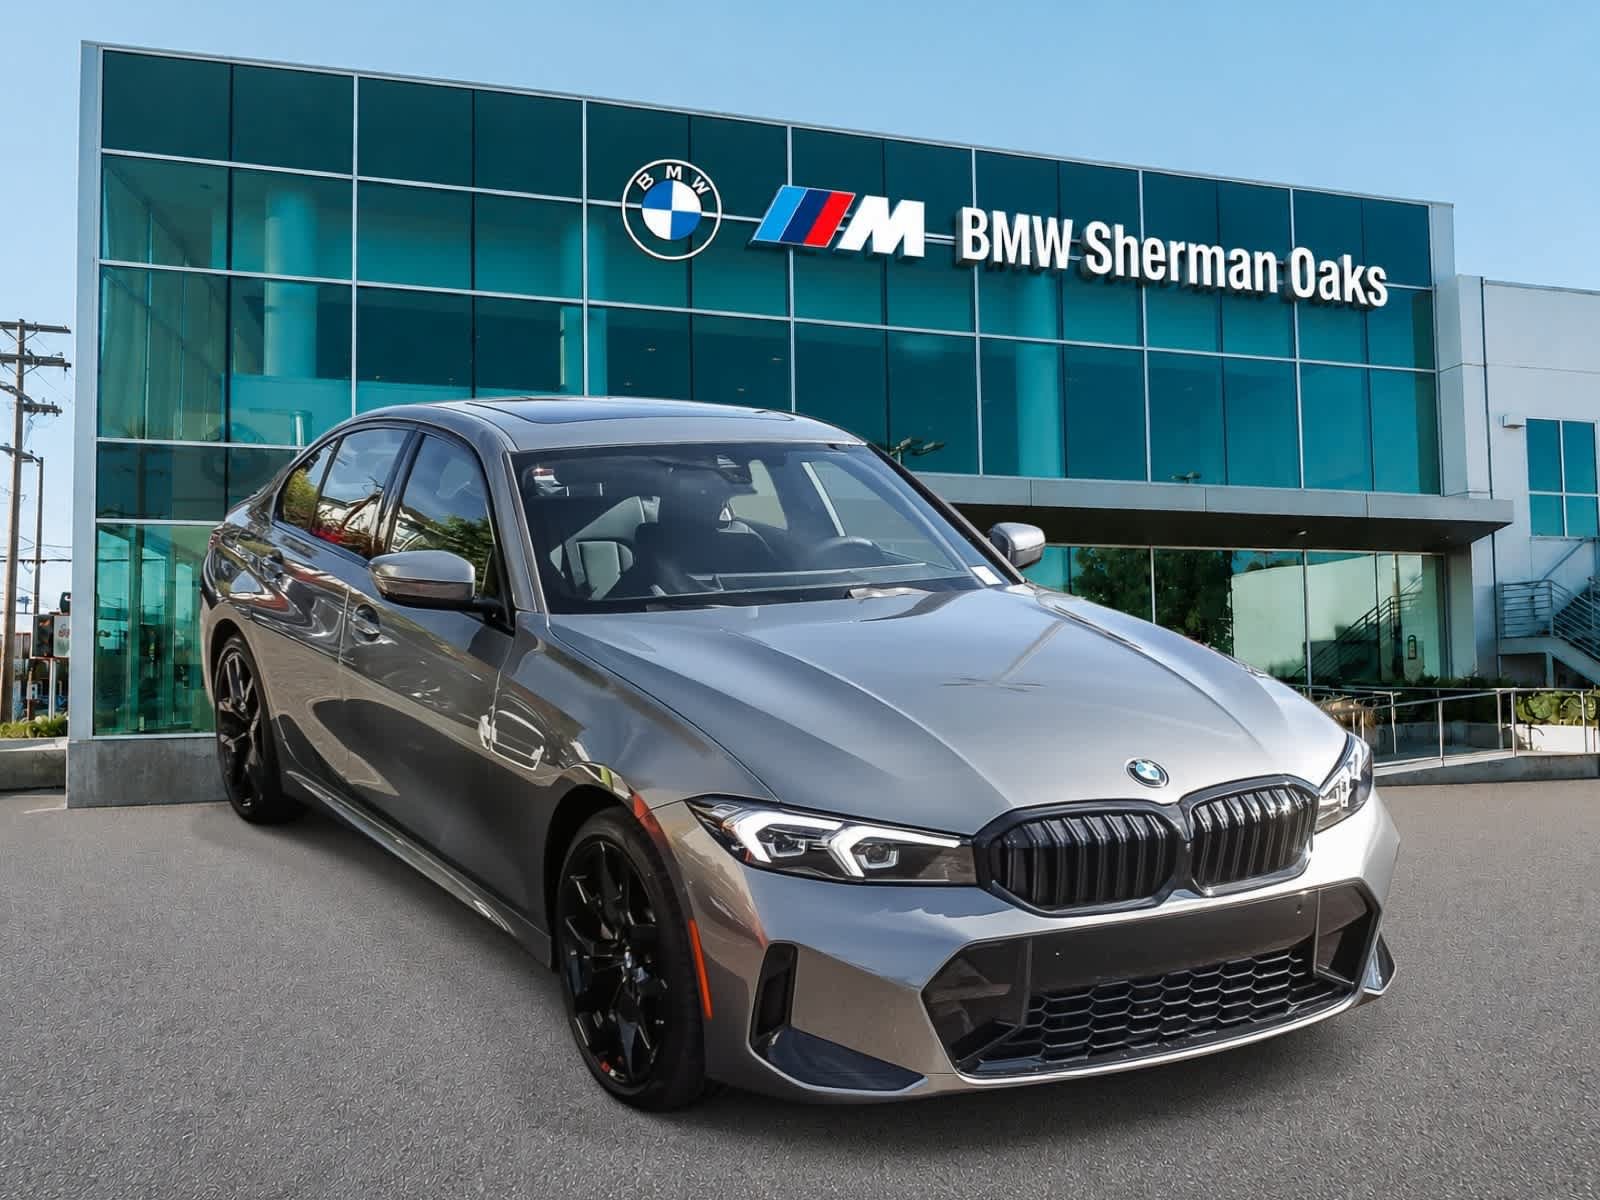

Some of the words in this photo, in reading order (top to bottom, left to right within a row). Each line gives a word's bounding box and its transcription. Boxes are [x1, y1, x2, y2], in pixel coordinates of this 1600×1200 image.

[636, 164, 711, 195] BMW
[960, 206, 1074, 270] BMW
[1084, 220, 1279, 294] Sherman
[1289, 246, 1389, 308] Oaks
